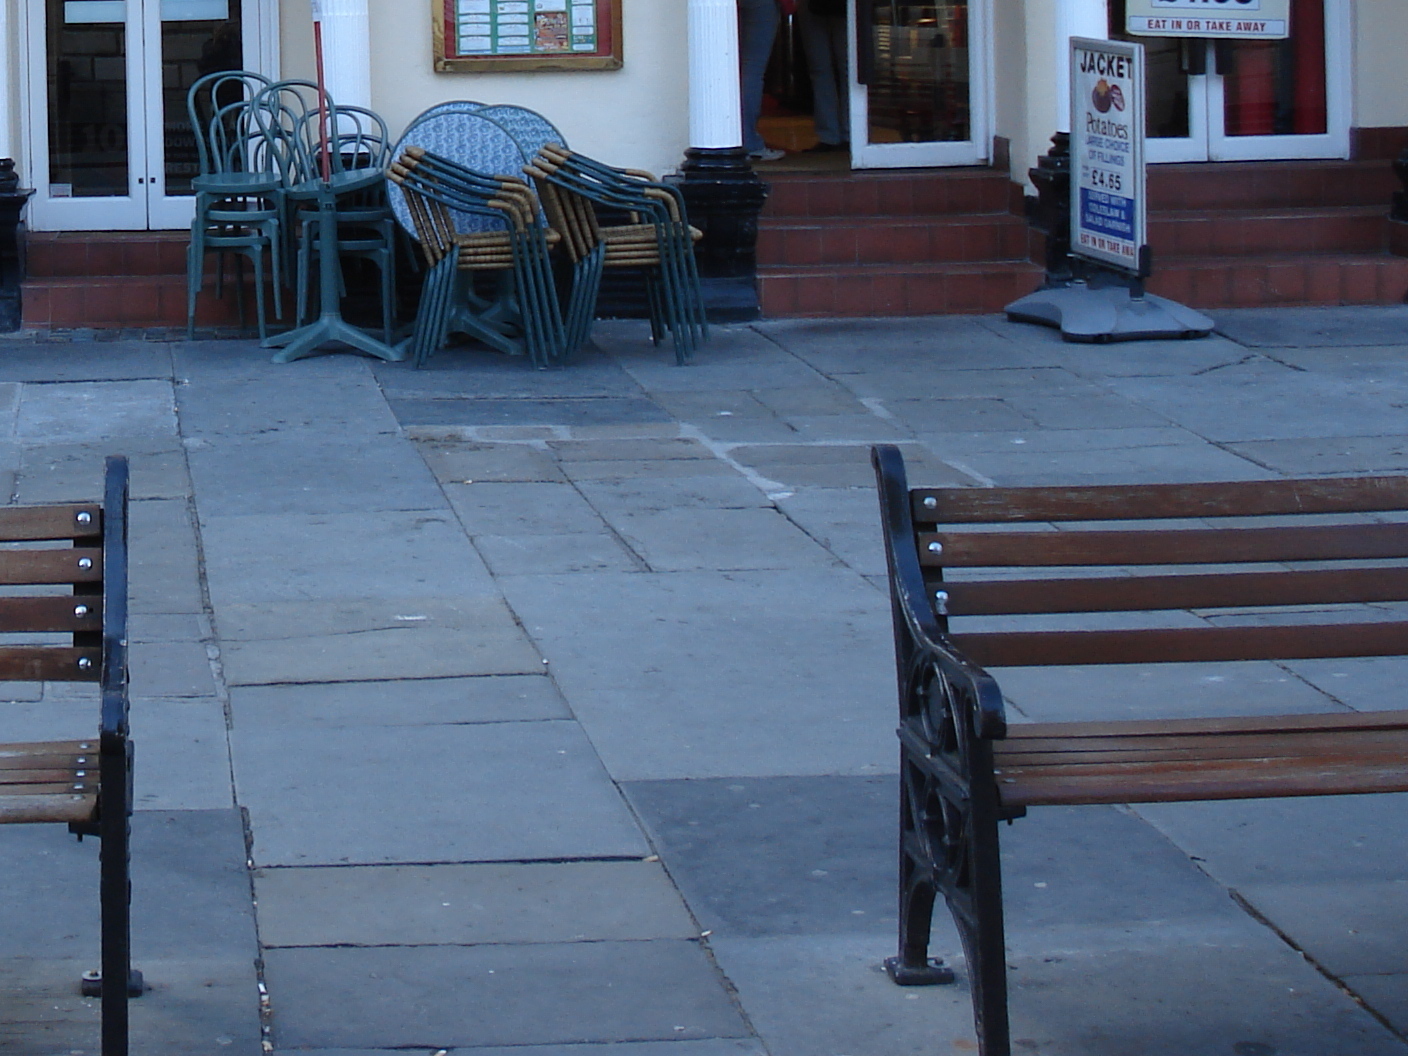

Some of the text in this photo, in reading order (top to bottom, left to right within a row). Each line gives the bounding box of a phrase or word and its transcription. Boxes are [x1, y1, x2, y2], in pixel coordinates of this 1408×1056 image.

[1148, 20, 1266, 32] EAT IN OR TAKE AWAY
[1081, 52, 1132, 79] JACKET
[1086, 112, 1128, 140] Potatoes
[1092, 170, 1121, 190] £4.65
[1122, 244, 1134, 256] AWA
